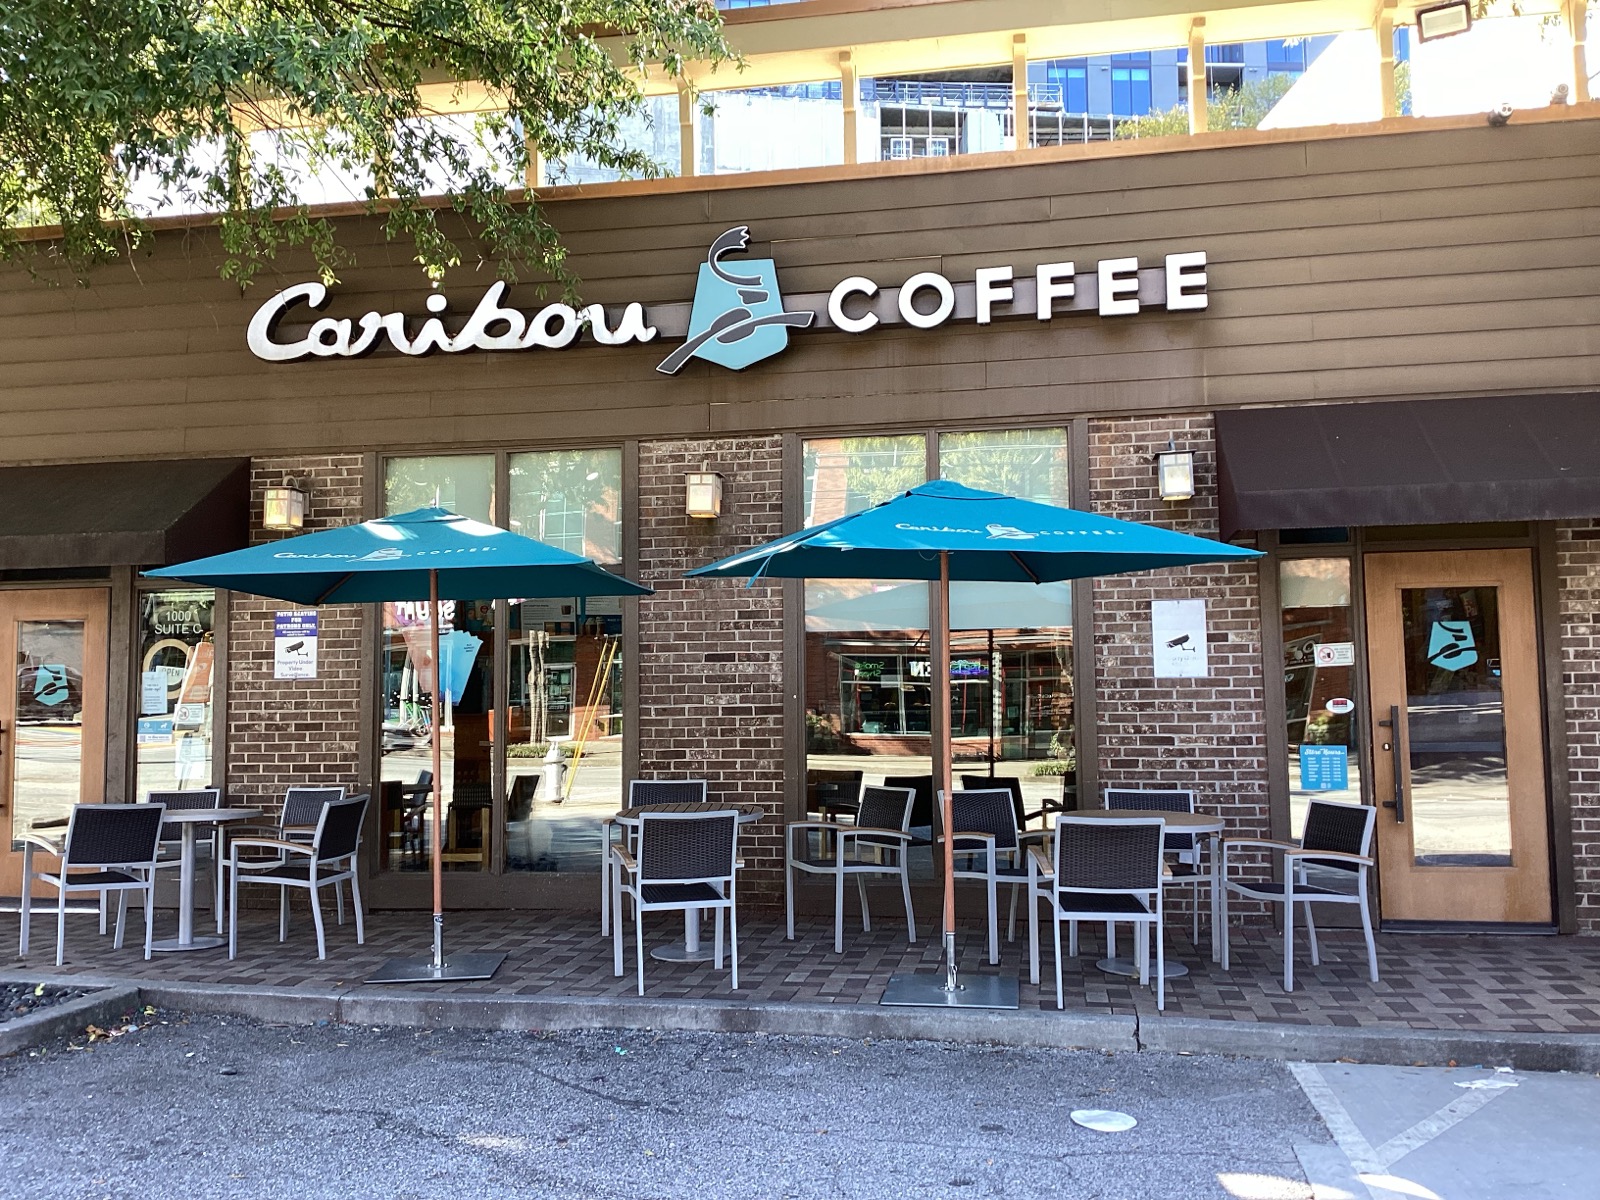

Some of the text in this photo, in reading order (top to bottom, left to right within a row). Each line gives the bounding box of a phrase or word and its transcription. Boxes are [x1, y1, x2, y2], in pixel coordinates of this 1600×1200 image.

[245, 250, 1209, 362] Caribou COFFEE
[894, 522, 984, 534] Caribou
[272, 546, 491, 559] Caribou COFFEE
[166, 610, 191, 621] 1000
[154, 623, 203, 634] SUITE C
